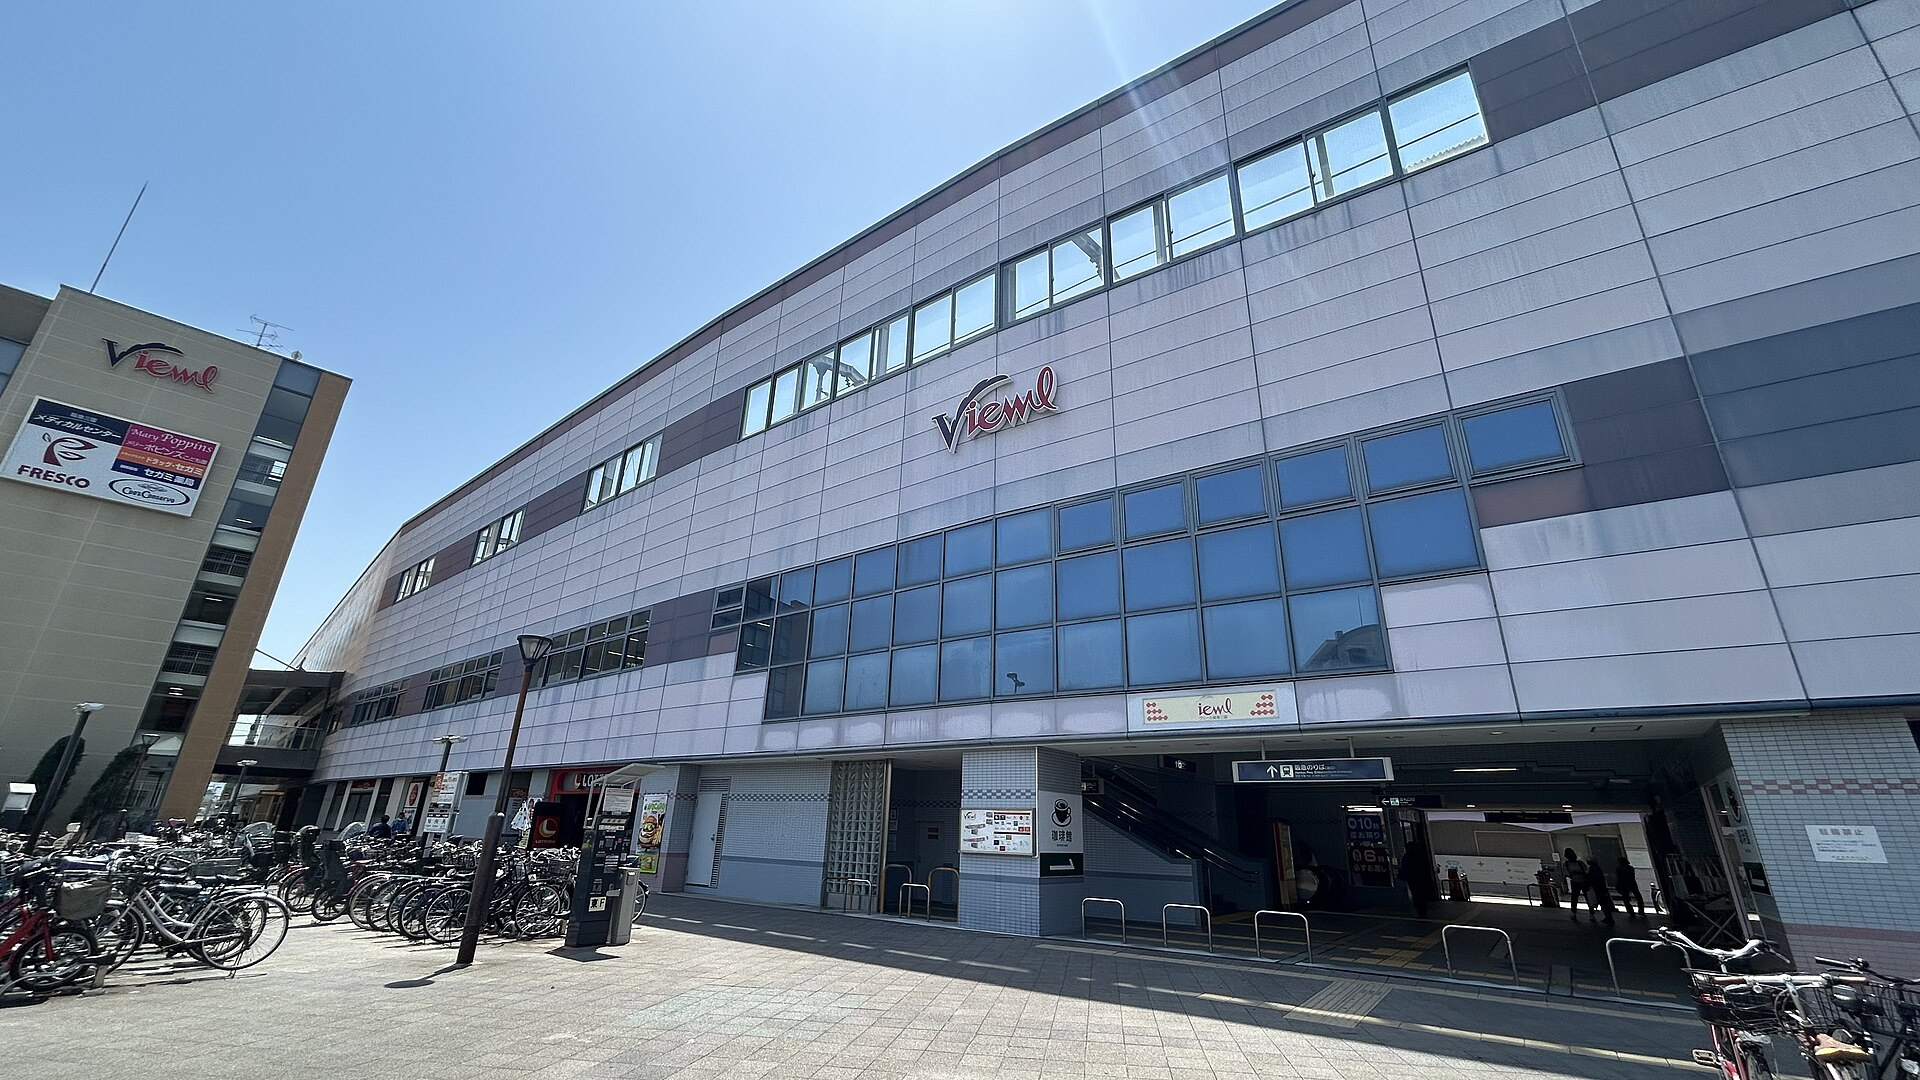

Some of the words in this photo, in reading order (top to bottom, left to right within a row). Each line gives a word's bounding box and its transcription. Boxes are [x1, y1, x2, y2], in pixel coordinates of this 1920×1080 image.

[931, 366, 1058, 454] Vieml
[33, 414, 122, 439] メディカルセンター
[131, 429, 160, 443] Mary
[161, 433, 213, 453] Poppins
[17, 464, 91, 489] FRESCO
